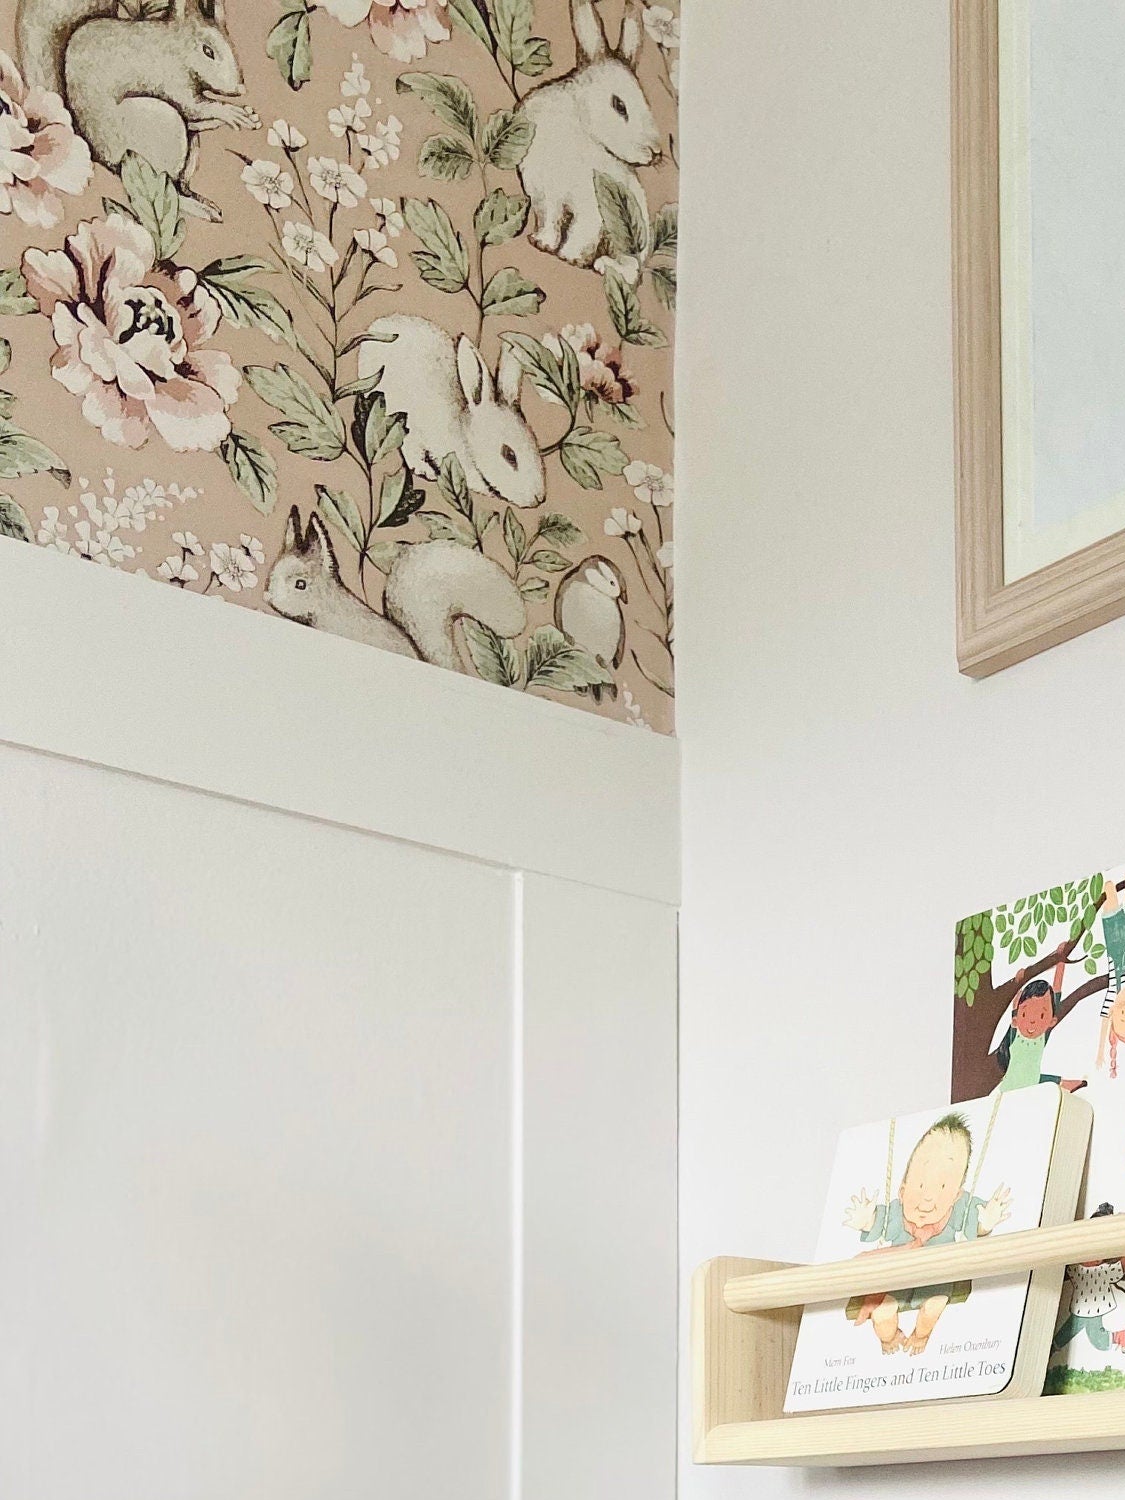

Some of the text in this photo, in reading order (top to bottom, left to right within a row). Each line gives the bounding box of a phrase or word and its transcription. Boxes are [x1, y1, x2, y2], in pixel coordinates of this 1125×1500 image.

[793, 1360, 1006, 1395] Ten Little Fingers and Ten Little Toes
